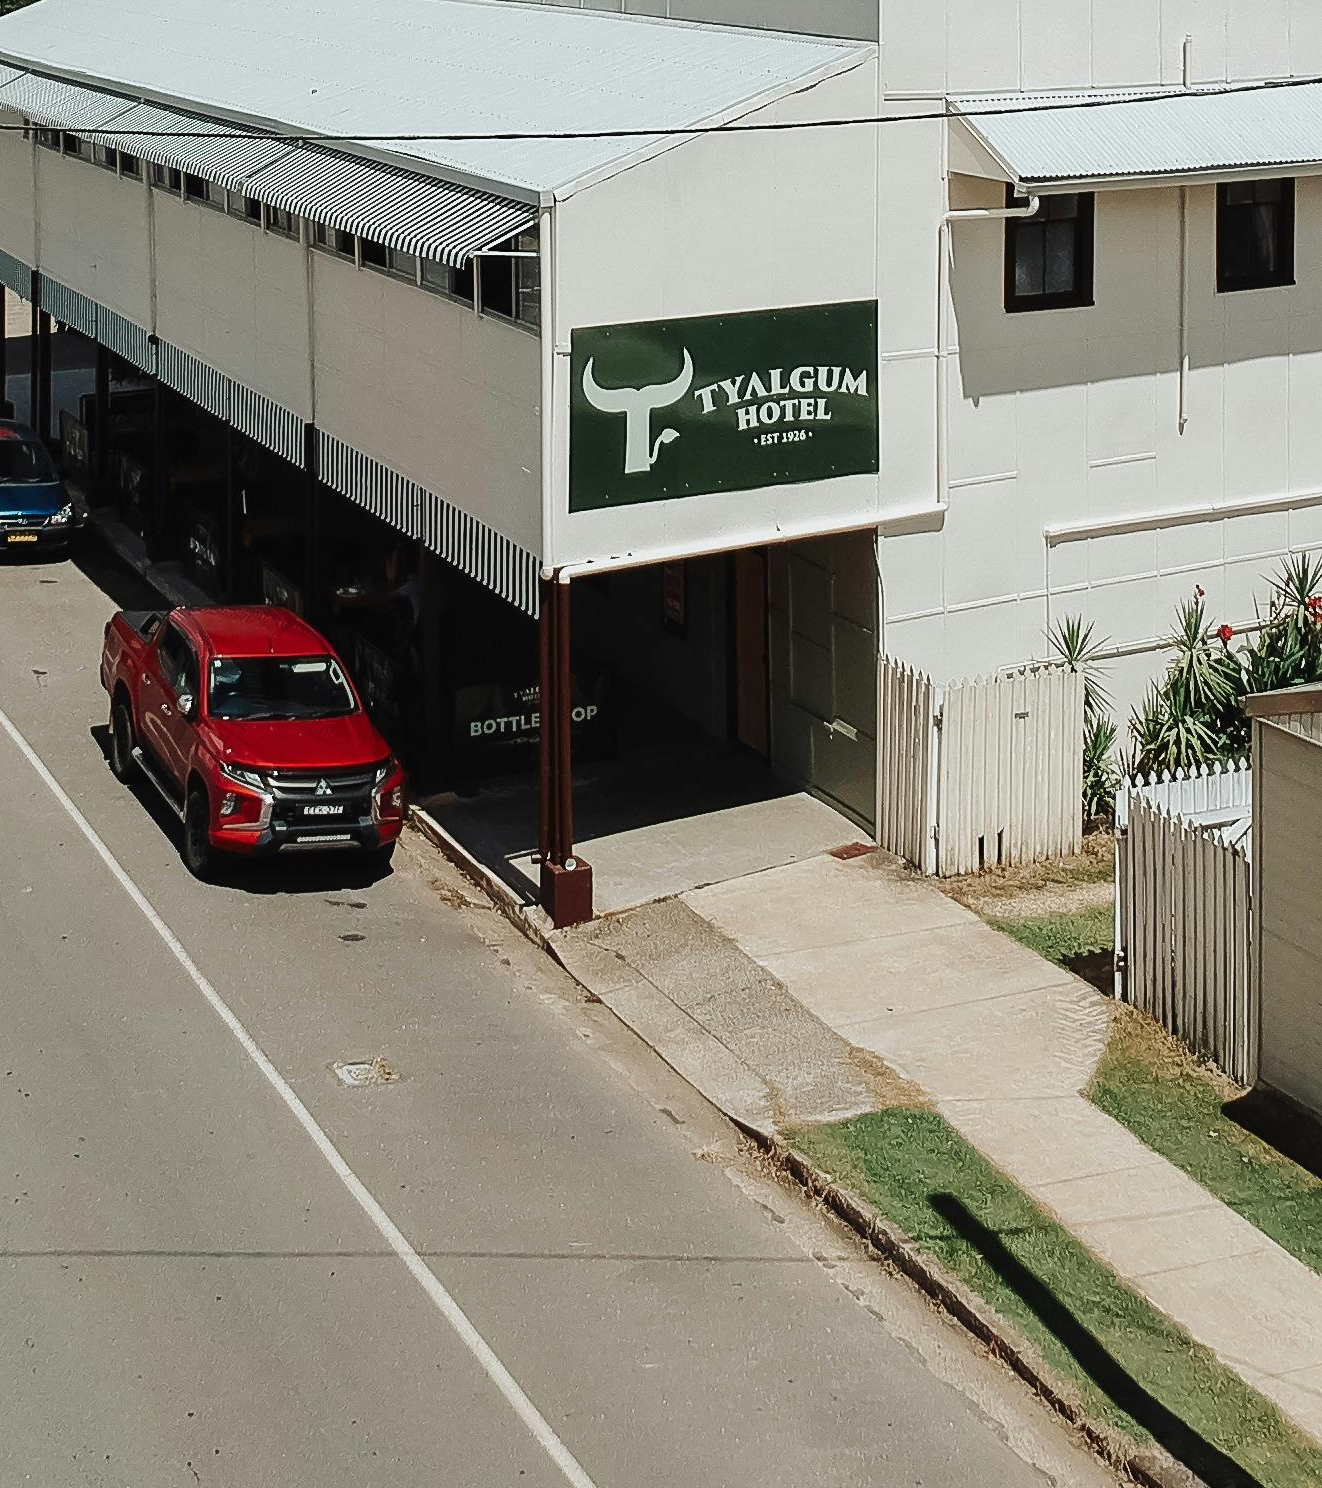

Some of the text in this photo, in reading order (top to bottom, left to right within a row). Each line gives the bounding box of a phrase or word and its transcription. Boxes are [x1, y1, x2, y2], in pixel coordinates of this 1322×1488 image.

[694, 366, 869, 414] TYALGUM
[736, 398, 831, 431] HOTEL
[760, 429, 807, 446] EST 1926
[470, 712, 540, 736] BOTTLE
